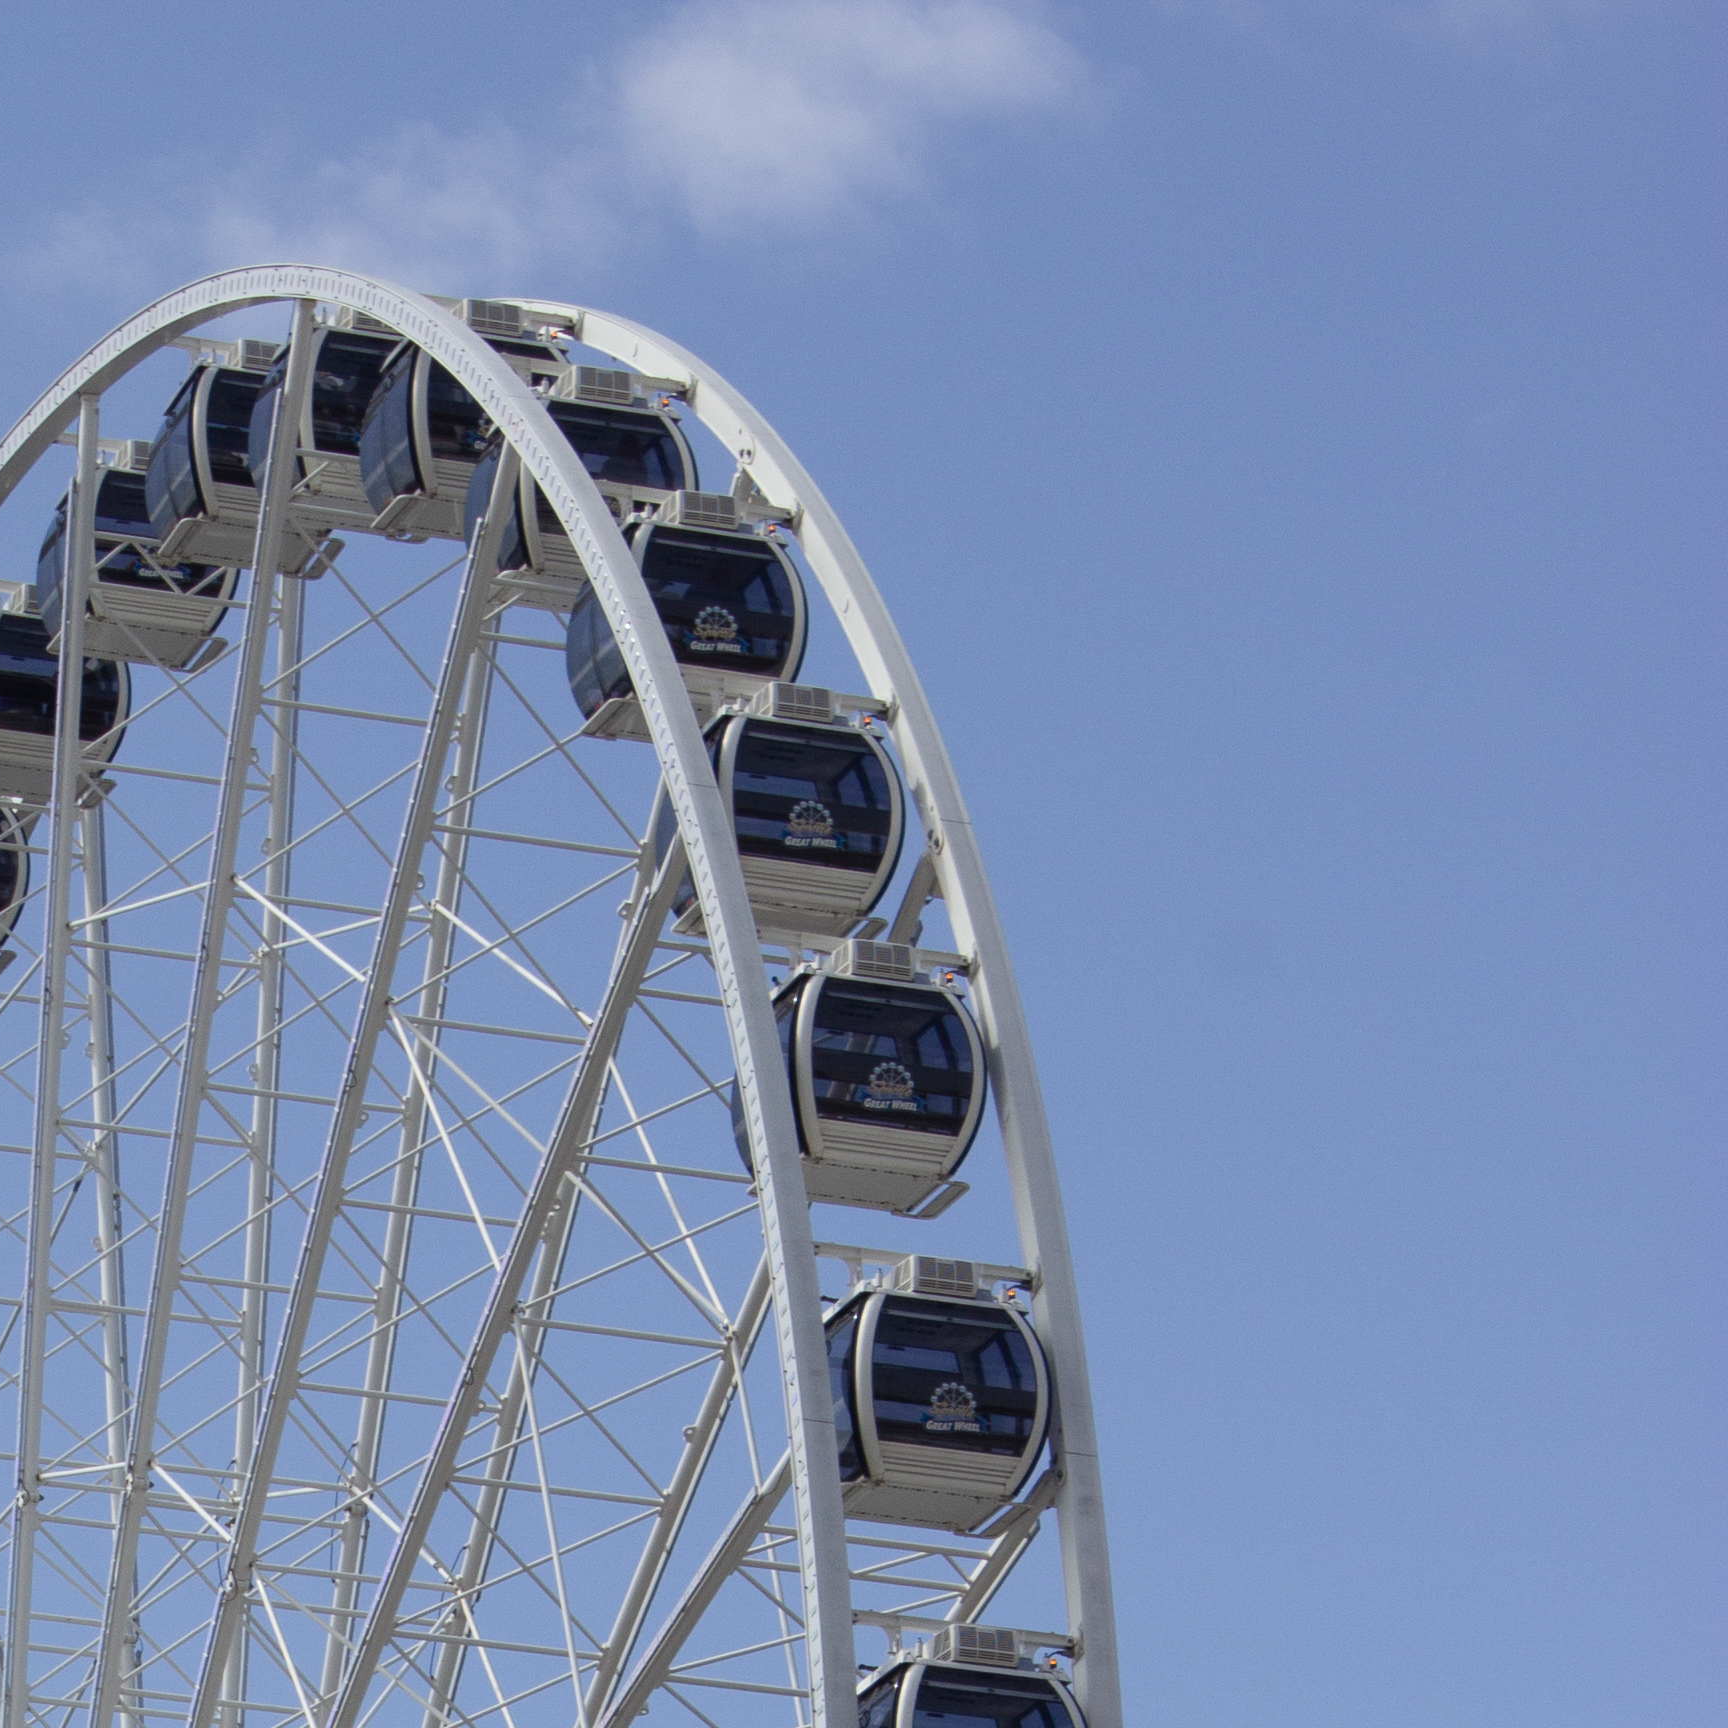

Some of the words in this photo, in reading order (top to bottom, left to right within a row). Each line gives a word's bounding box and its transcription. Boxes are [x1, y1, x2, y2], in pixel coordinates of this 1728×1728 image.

[690, 641, 715, 650] GREAT
[716, 642, 741, 653] WHEEL
[785, 836, 810, 847] GREAT
[812, 838, 837, 848] WHEEL
[864, 1098, 890, 1109] GREAT
[892, 1100, 917, 1111] WHEEL
[926, 1420, 953, 1430] GREAT
[954, 1421, 980, 1432] WHEEL
